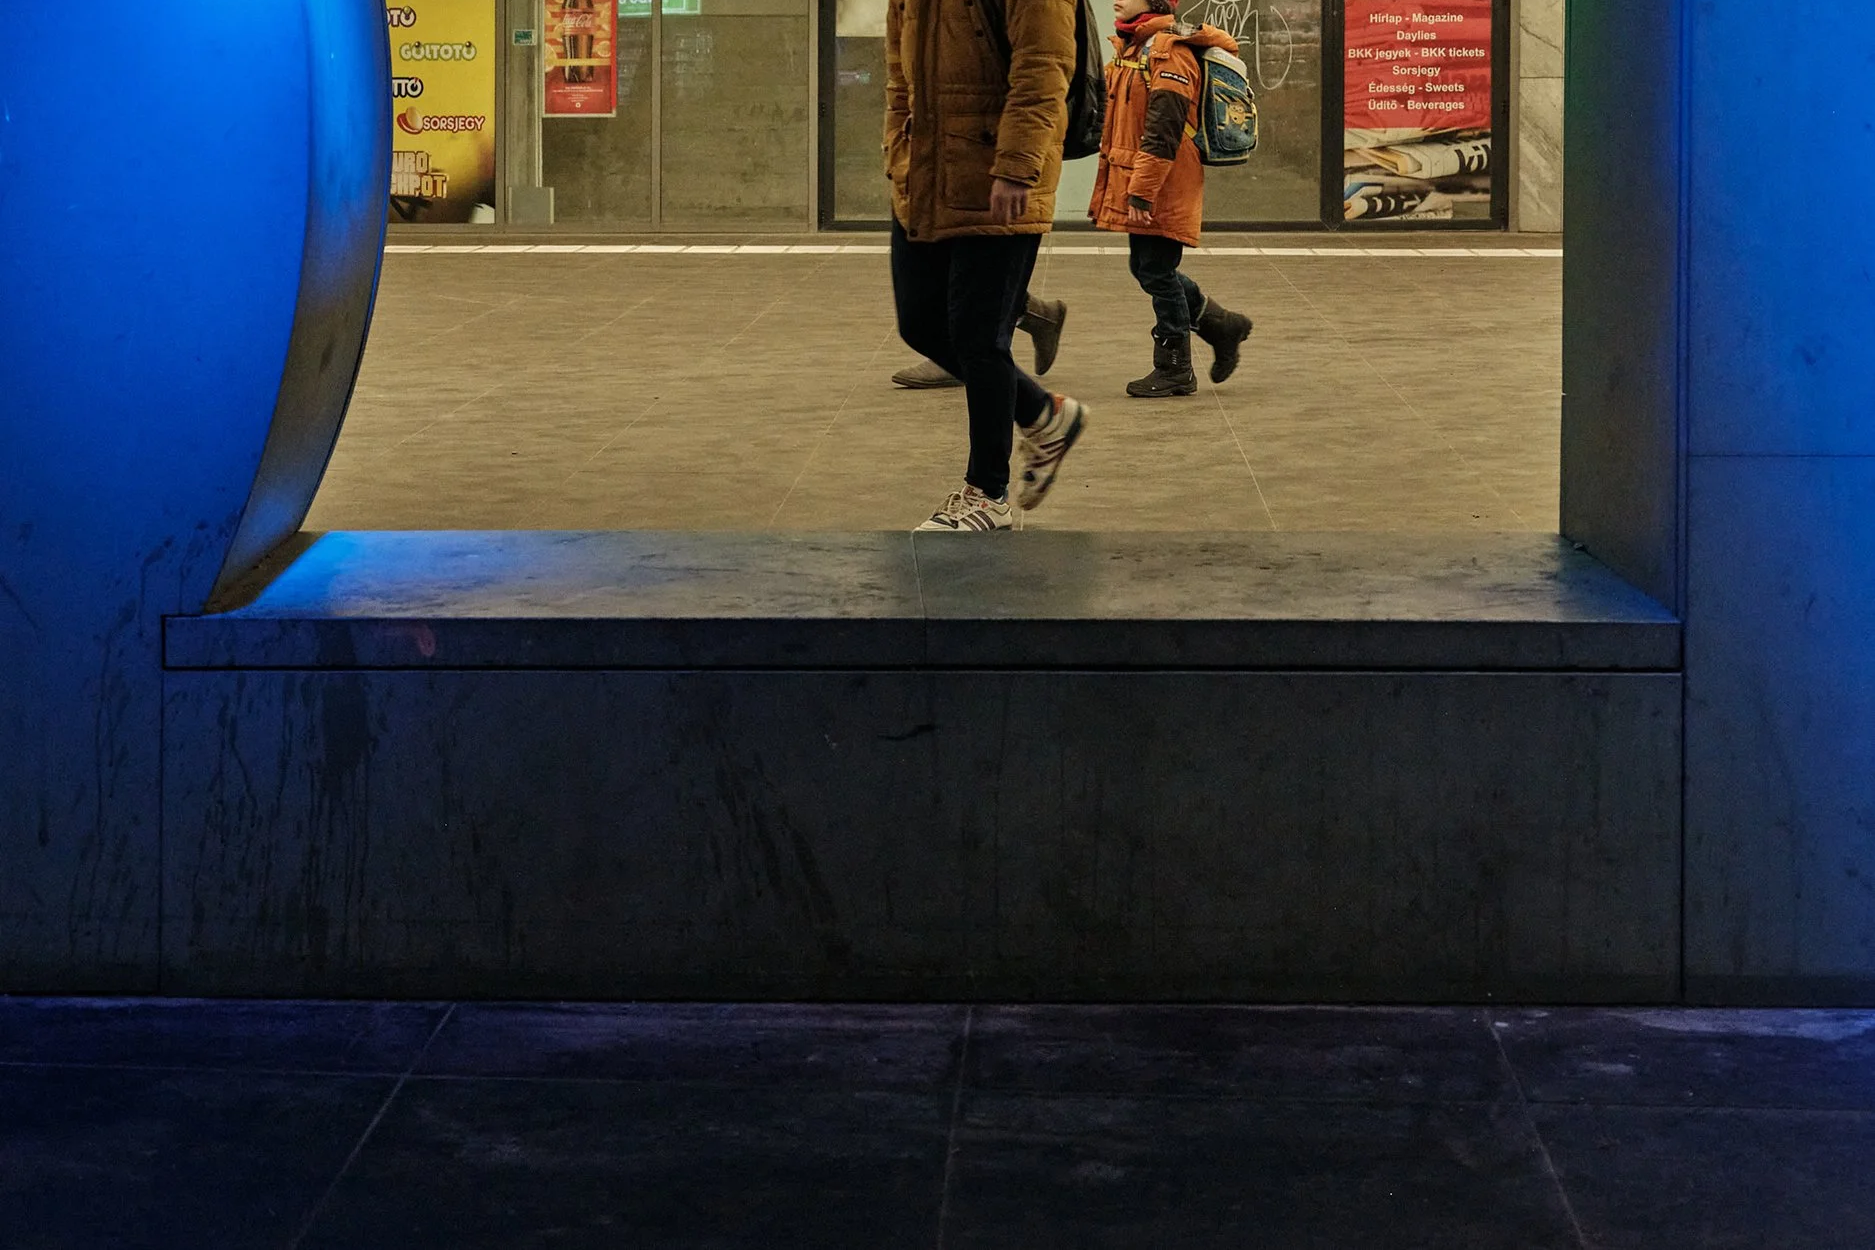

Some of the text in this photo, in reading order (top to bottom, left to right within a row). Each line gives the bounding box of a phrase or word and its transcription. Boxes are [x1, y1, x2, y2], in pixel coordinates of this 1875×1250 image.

[1369, 13, 1402, 24] Hírlap
[1412, 13, 1464, 24] Magazine
[1396, 31, 1436, 42] Daylies
[1348, 49, 1373, 58] BKK
[1375, 49, 1411, 60] jegyek
[1421, 48, 1446, 57] BKK
[1449, 48, 1485, 57] tickets
[1392, 66, 1440, 76] Sorsjegy
[1368, 82, 1415, 94] Édesség
[1425, 83, 1465, 92] Sweets
[1407, 100, 1465, 111] Beverages
[422, 116, 486, 133] SORSJEGY
